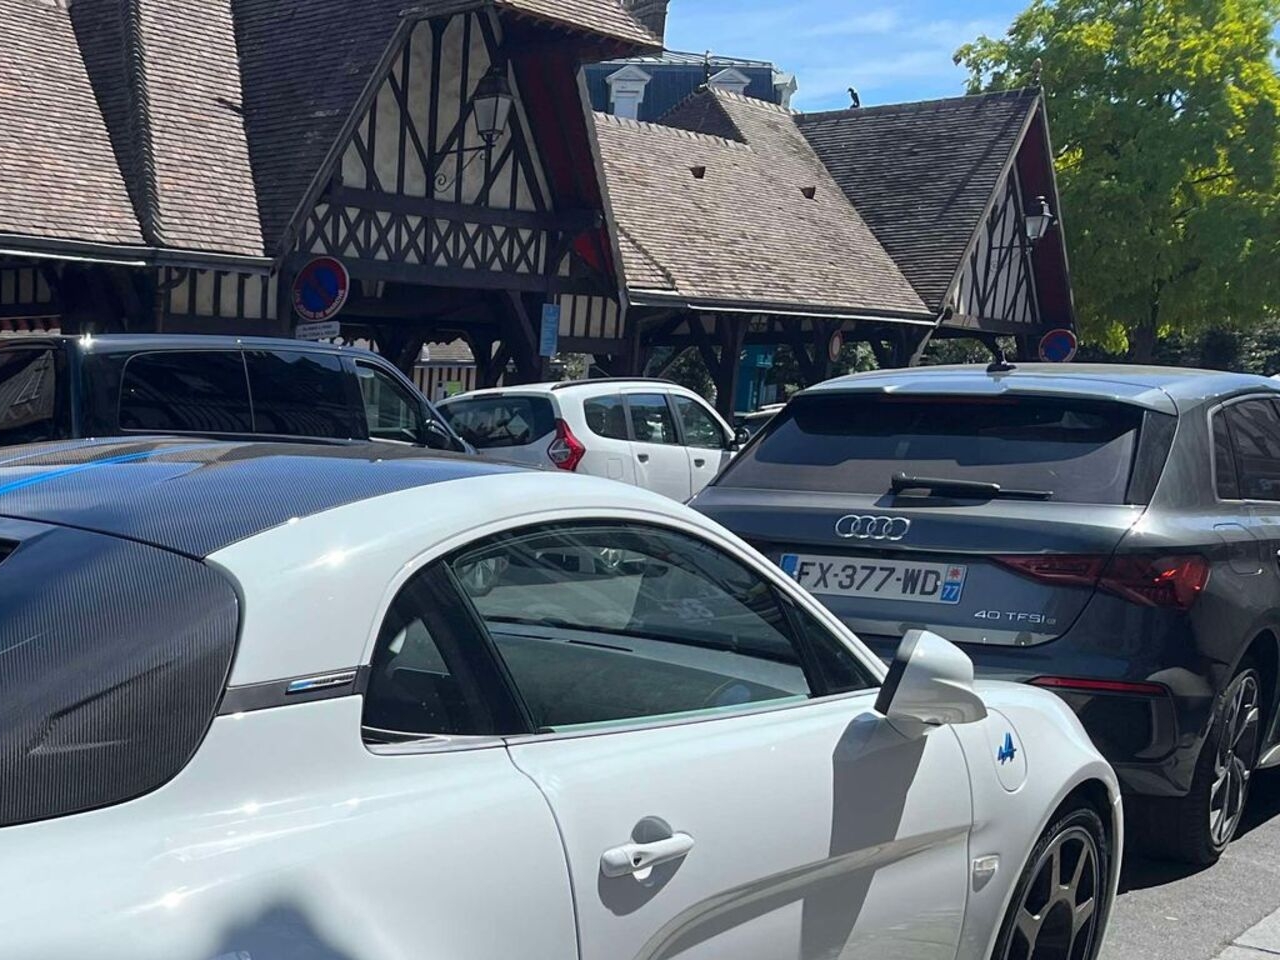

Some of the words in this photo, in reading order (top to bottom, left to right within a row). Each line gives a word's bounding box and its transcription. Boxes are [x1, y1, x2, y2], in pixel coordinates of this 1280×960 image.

[797, 561, 941, 596] FX-377-WD
[942, 585, 959, 599] 77
[974, 610, 1000, 620] 40
